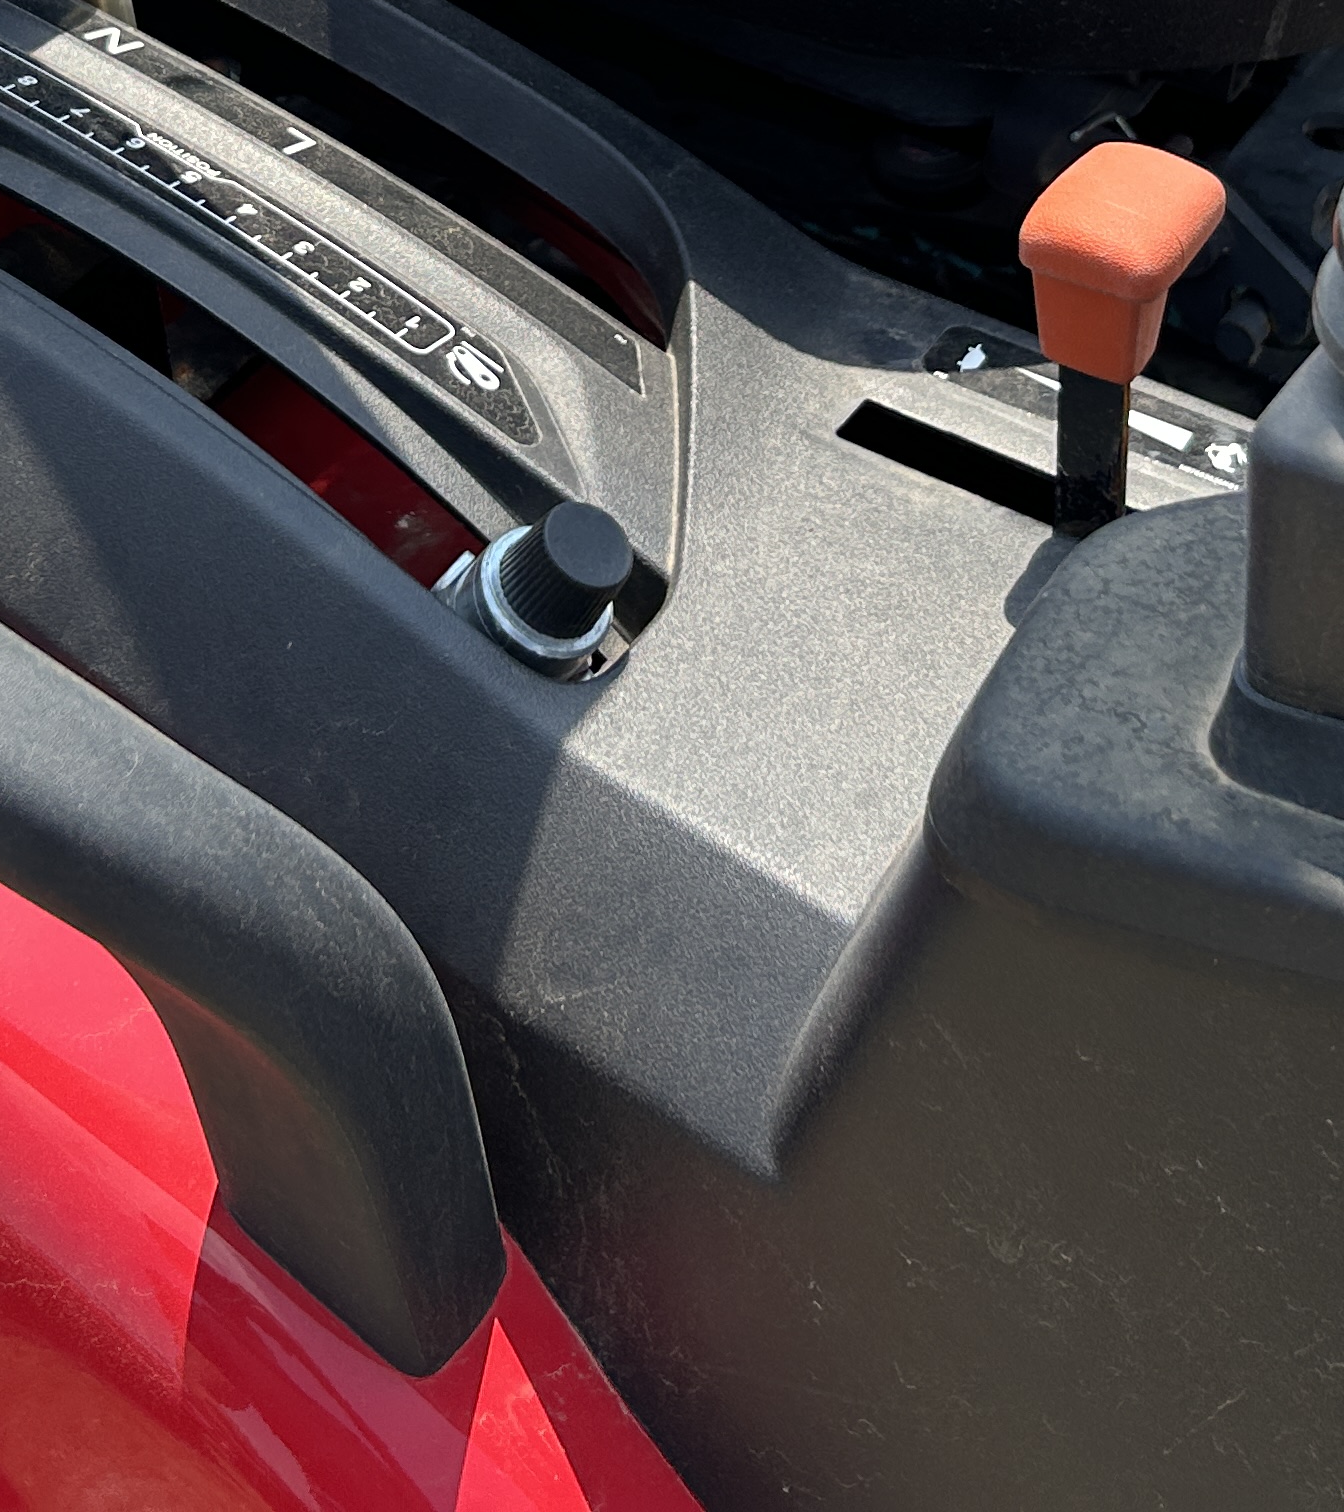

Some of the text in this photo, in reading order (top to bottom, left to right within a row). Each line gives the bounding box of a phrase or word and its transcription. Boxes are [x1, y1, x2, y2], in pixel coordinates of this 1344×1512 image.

[83, 26, 145, 56] N
[16, 74, 39, 88] 8
[68, 106, 92, 118] 7
[282, 126, 318, 156] L
[147, 132, 222, 177] POSITION
[179, 170, 203, 184] 5
[235, 203, 259, 217] 4
[292, 240, 316, 255] 3
[348, 276, 372, 293] 2
[404, 315, 421, 331] 1
